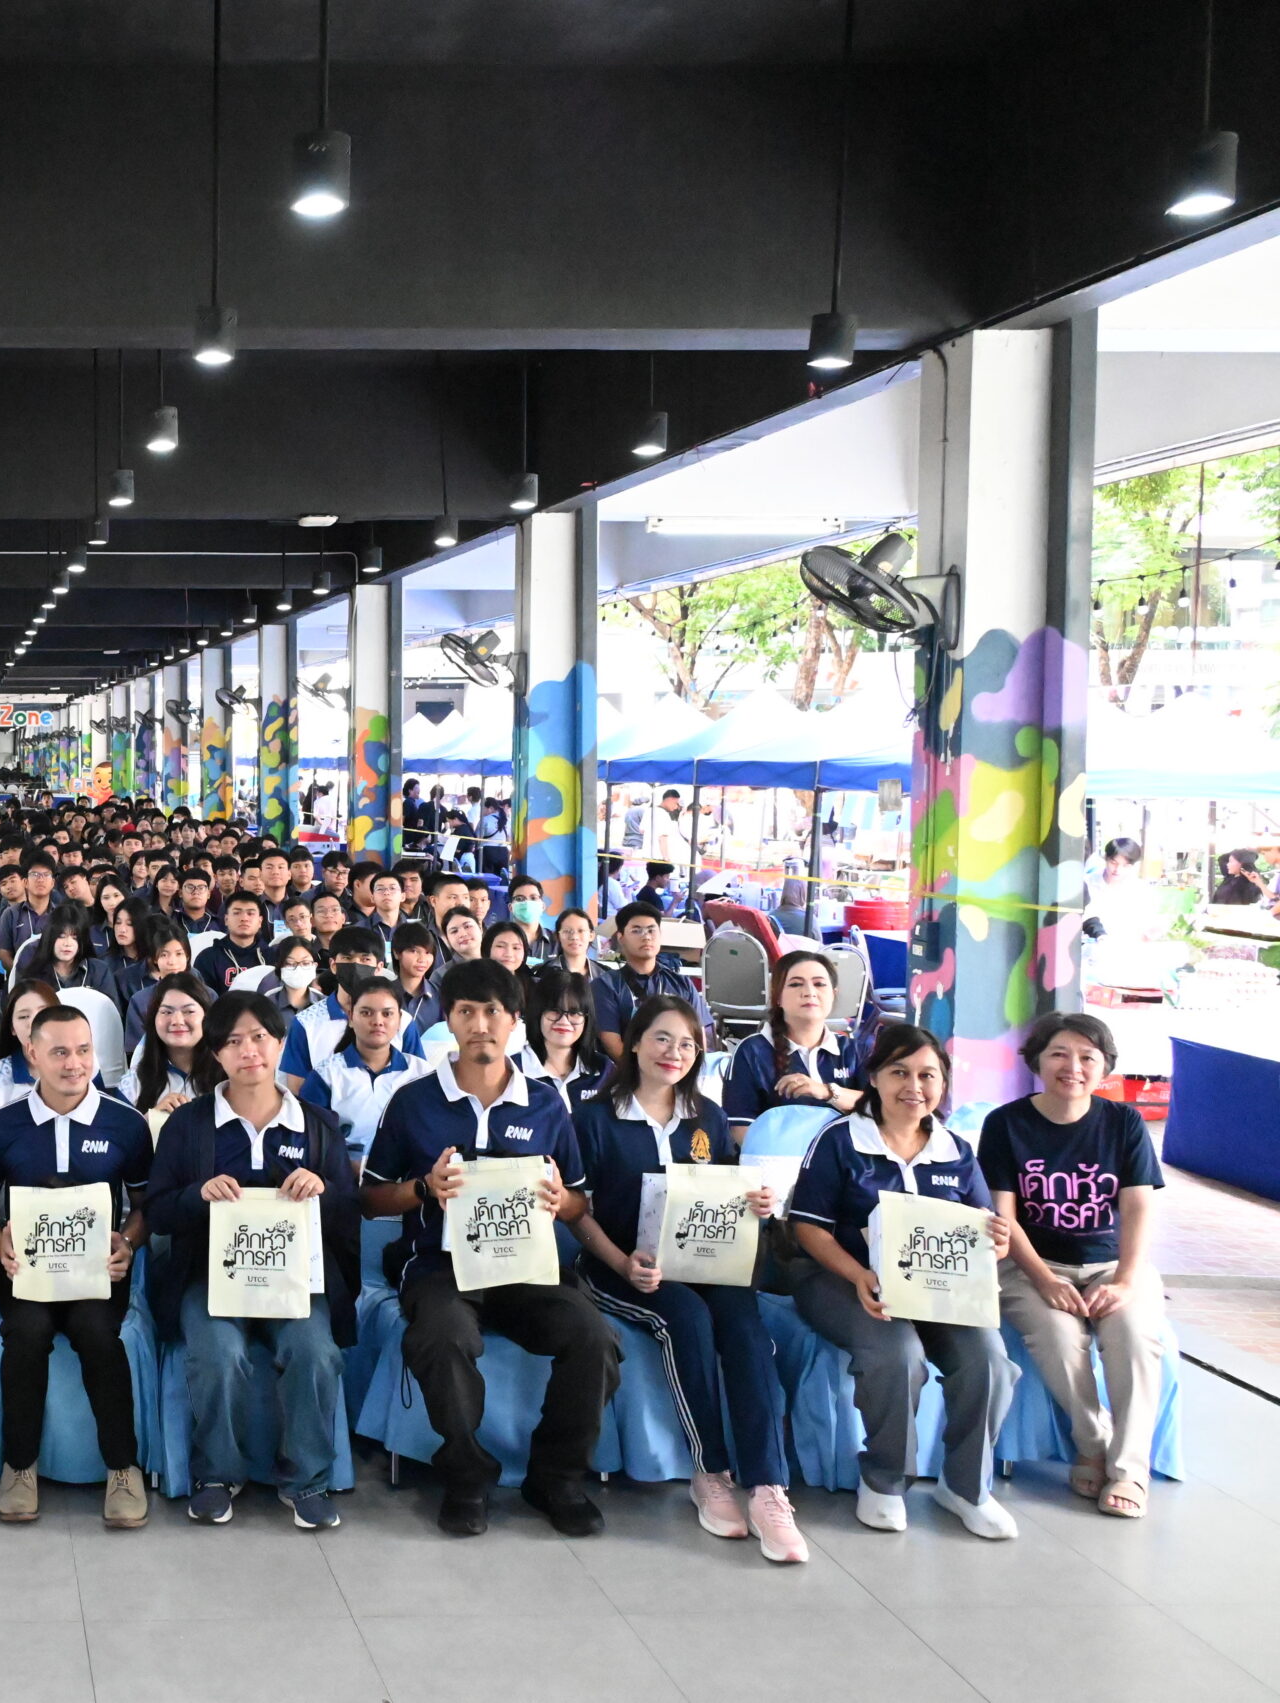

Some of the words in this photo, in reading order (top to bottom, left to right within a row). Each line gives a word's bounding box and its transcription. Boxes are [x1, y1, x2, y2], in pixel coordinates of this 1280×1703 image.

[505, 1125, 533, 1142] RNM
[81, 1139, 109, 1154] RNM
[278, 1144, 305, 1160] RNM
[931, 1174, 959, 1188] RNM
[1018, 1159, 1119, 1200] เด็กหัว
[474, 1195, 529, 1221] เด็กหัว
[687, 1201, 738, 1225] เด็กหัว
[1024, 1194, 1115, 1229] การค้า
[35, 1214, 86, 1238] เด็กหัว
[477, 1214, 531, 1238] การค้า
[686, 1220, 736, 1240] การค้า
[35, 1233, 86, 1253] การค้า
[234, 1224, 286, 1249] เด็กหัว
[910, 1226, 968, 1254] เด็กหัว
[234, 1246, 286, 1266] การค้า
[696, 1246, 716, 1254] UTCC
[910, 1250, 968, 1272] การค้า
[247, 1275, 267, 1283] UTCC
[926, 1278, 948, 1287] UTCC
